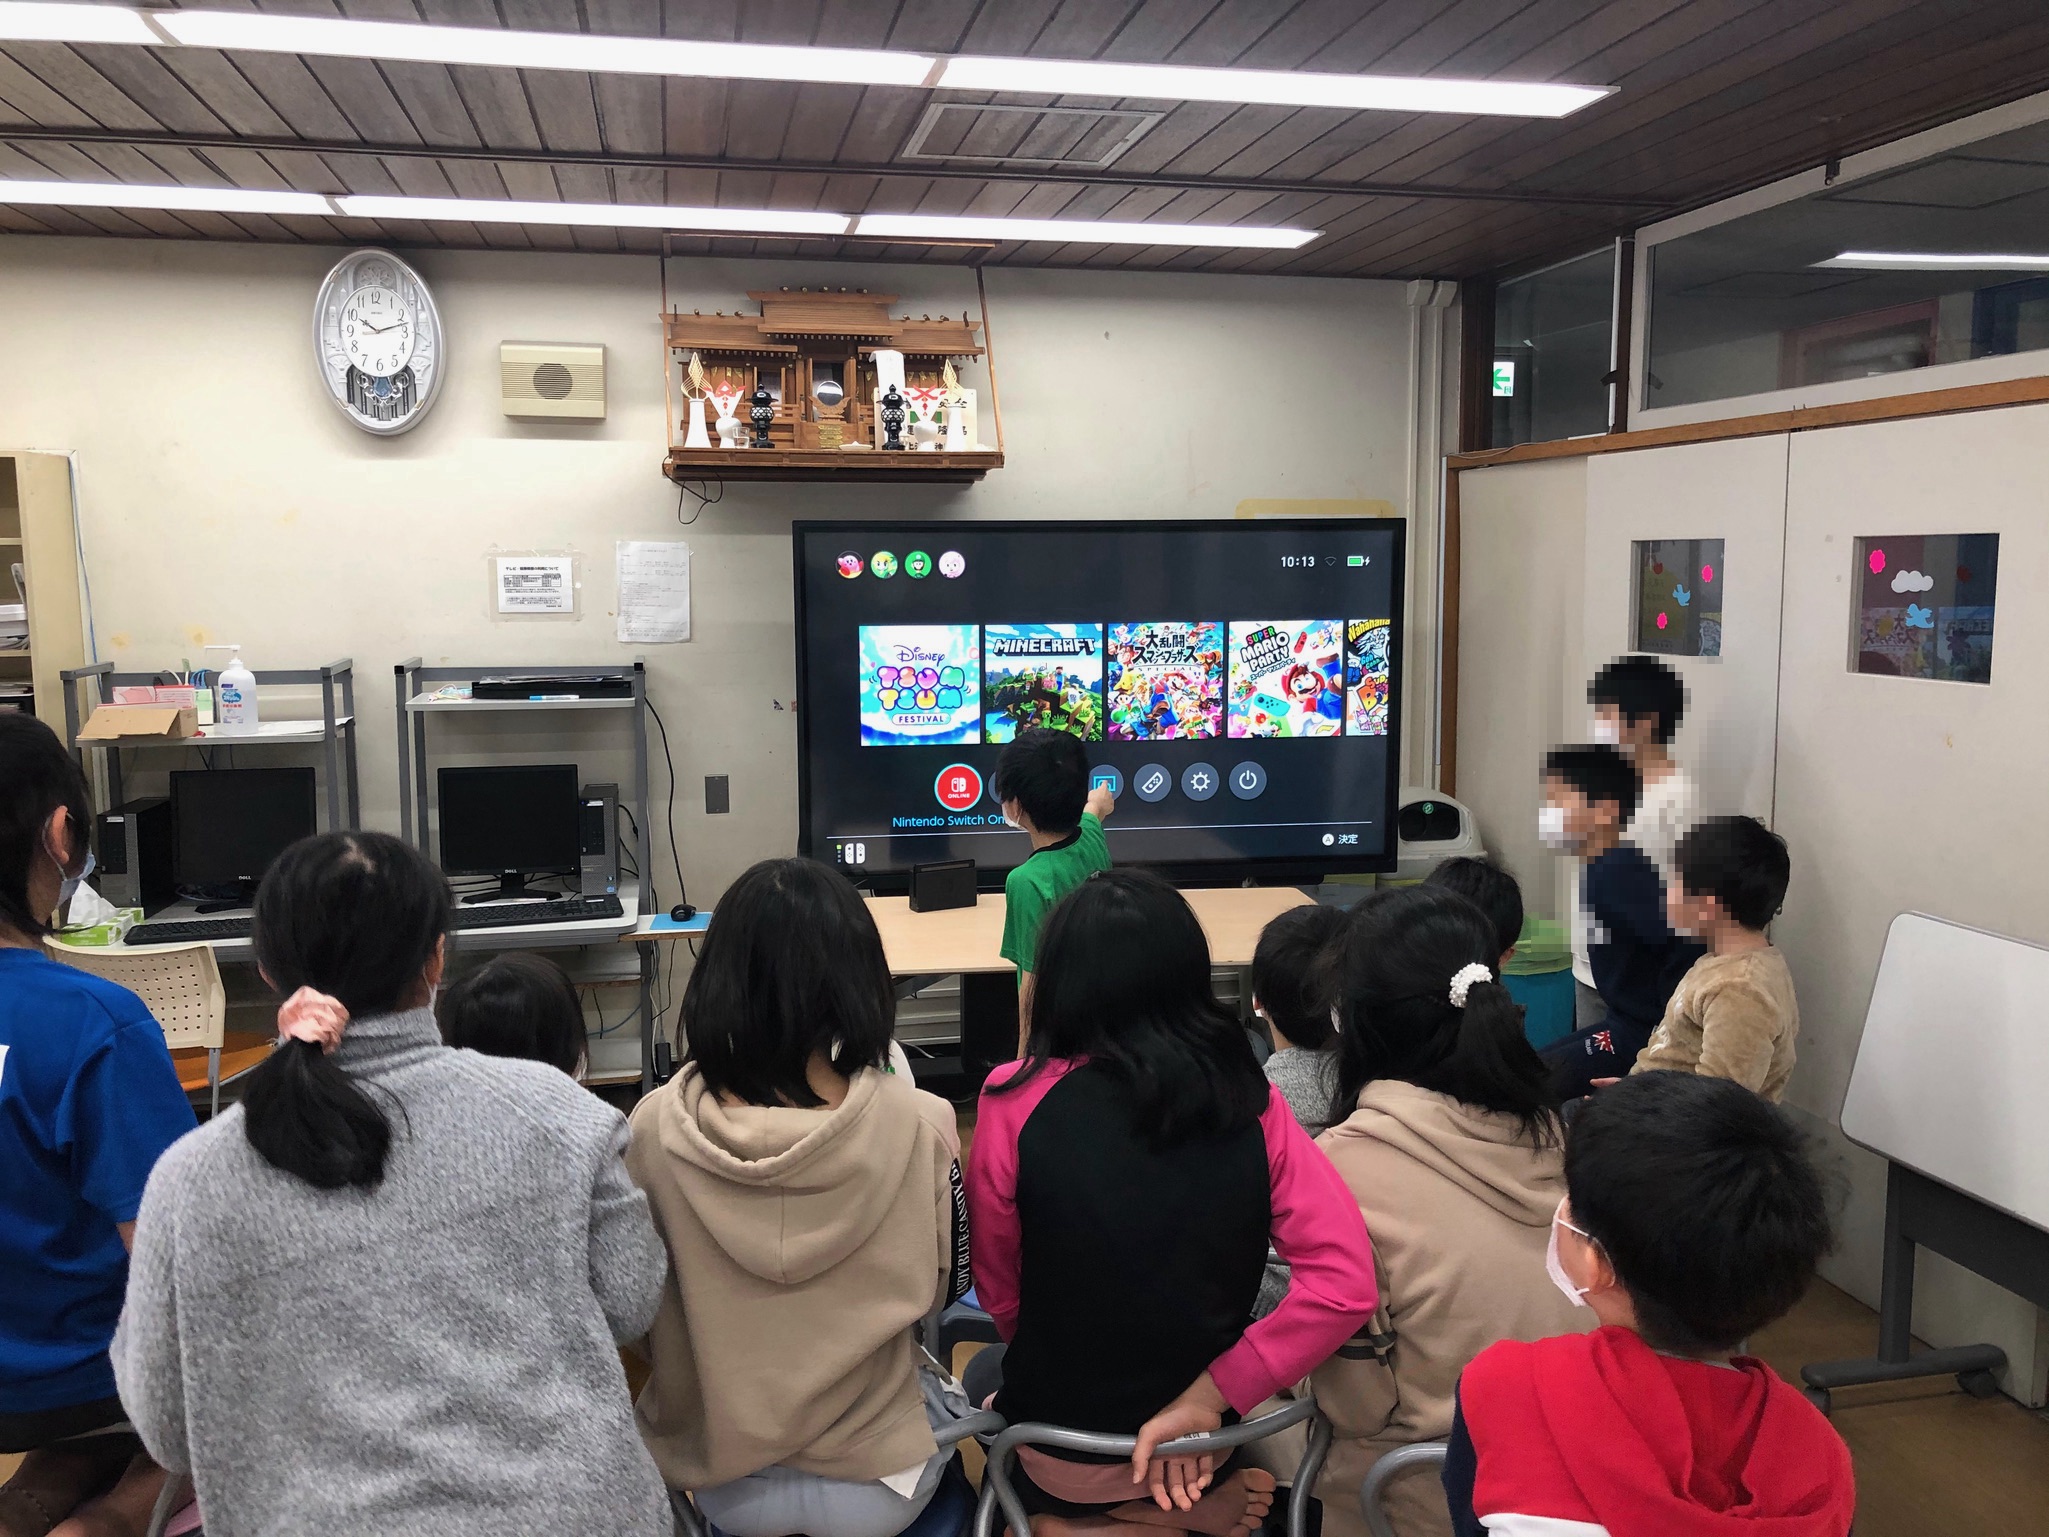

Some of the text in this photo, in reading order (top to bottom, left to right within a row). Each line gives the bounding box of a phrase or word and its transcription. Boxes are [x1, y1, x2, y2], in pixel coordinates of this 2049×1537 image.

[357, 295, 365, 308] 11
[371, 291, 380, 305] 12
[348, 309, 358, 321] 10
[397, 309, 405, 322] 2
[347, 324, 354, 337] 9
[401, 326, 409, 339] 3
[351, 340, 358, 353] 8
[399, 341, 405, 354] 4
[361, 354, 368, 367] 7
[376, 359, 383, 371] 6
[391, 355, 398, 367] 5
[1281, 556, 1315, 567] 10:13
[1146, 631, 1185, 649] 大乱闘
[1246, 626, 1276, 645] SUPER
[993, 638, 1096, 656] MINECRAFT
[1132, 643, 1201, 664] スマッシュブラザーズ
[1240, 631, 1290, 663] MARIO
[1249, 645, 1289, 672] PARTY
[877, 665, 965, 689] TSUM
[877, 688, 962, 711] TSUM
[898, 715, 944, 723] FESTIVAL
[892, 814, 1004, 827] Nintendo Switch On
[1338, 834, 1358, 844] 決定
[952, 1182, 969, 1232] CANDY
[958, 1230, 970, 1266] BLUE
